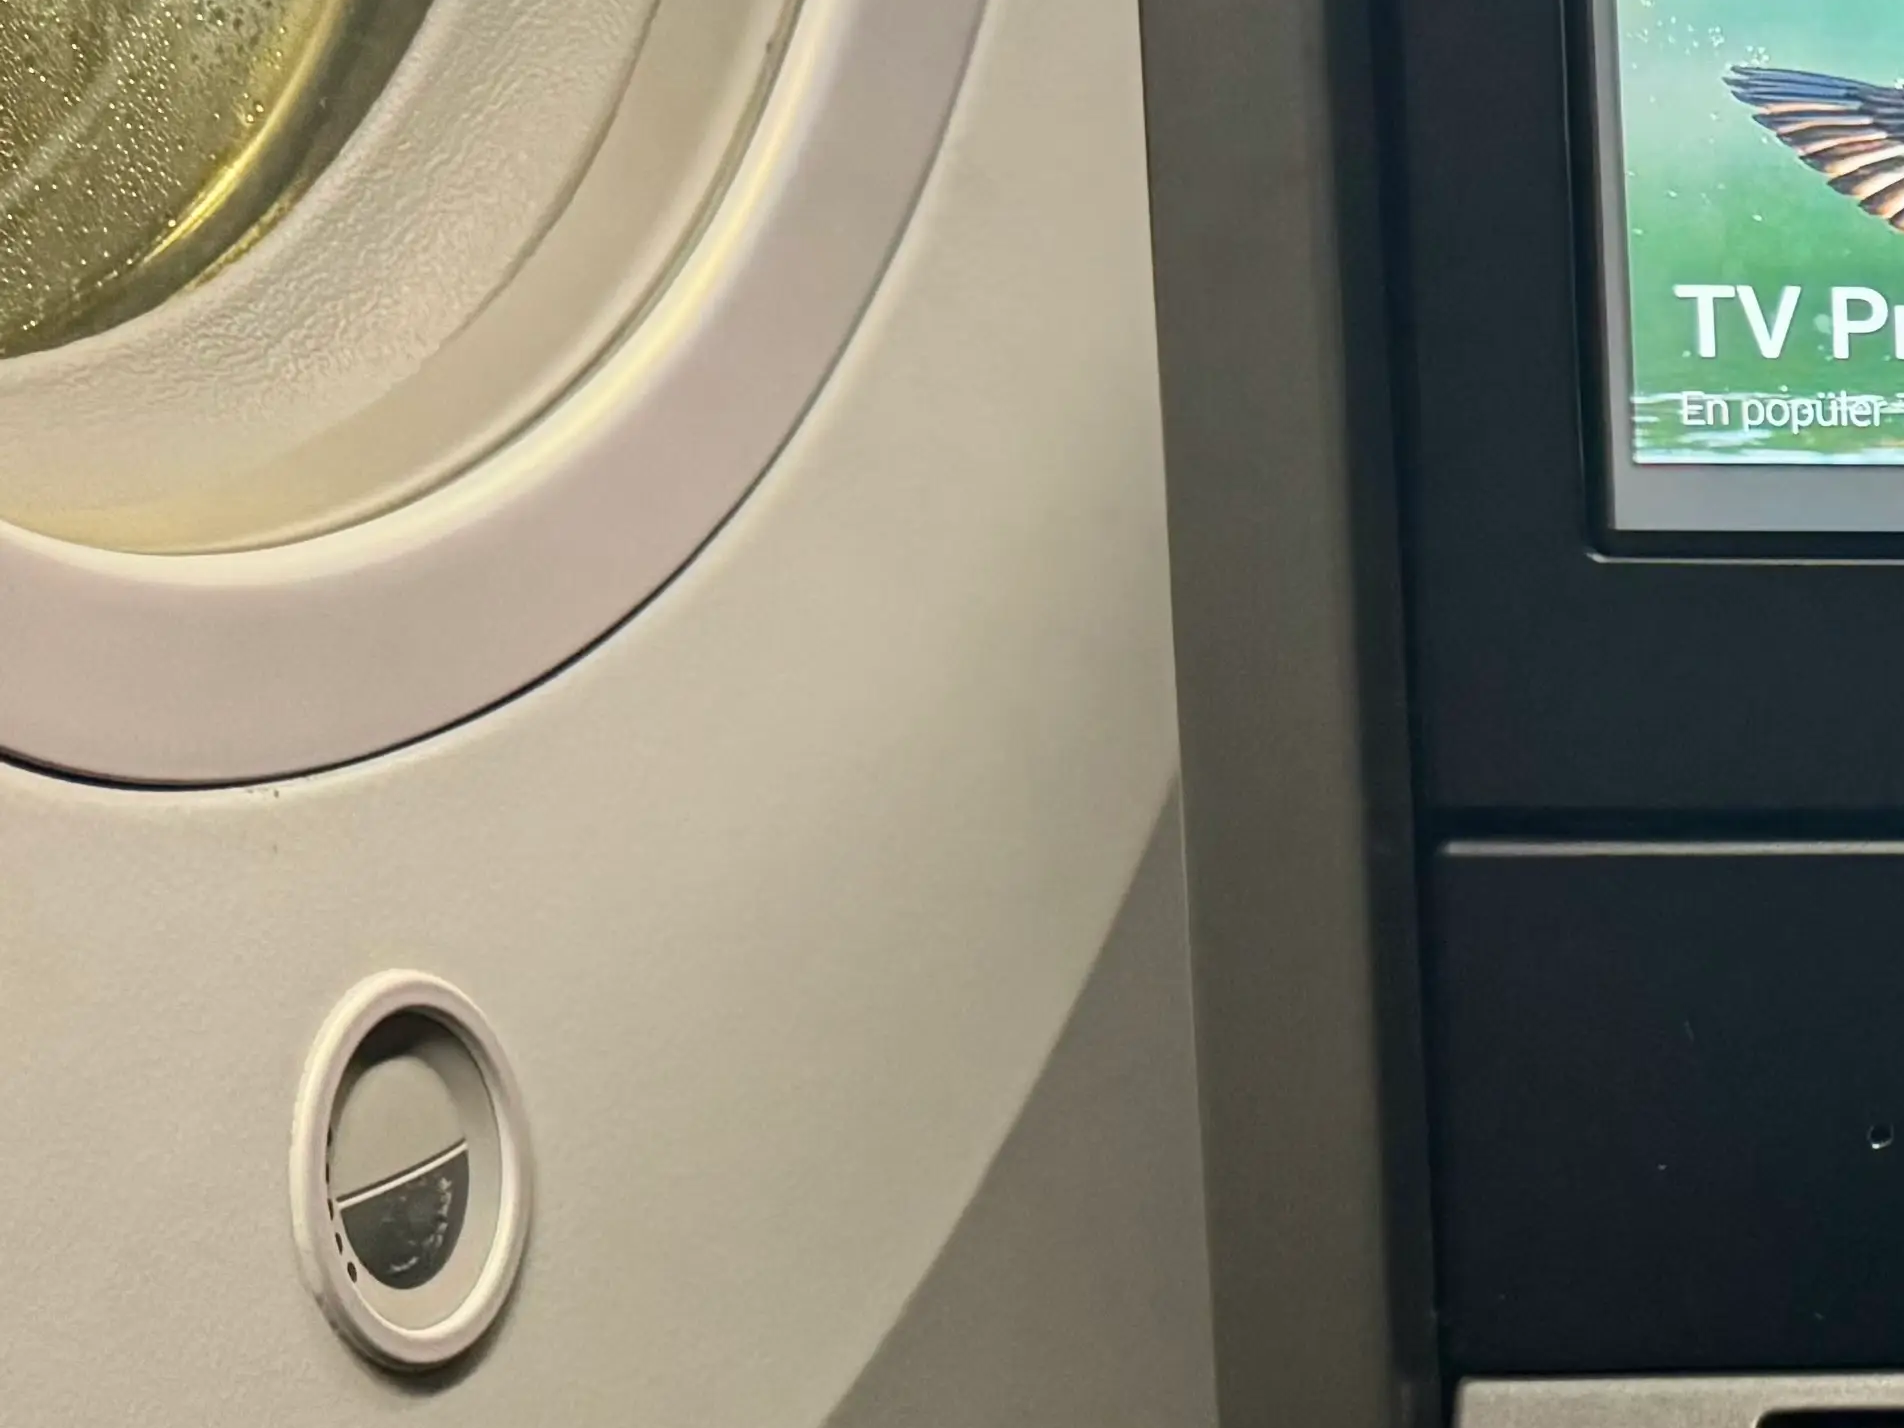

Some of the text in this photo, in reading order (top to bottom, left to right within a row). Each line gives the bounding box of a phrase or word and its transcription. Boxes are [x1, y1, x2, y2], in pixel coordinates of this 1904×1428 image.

[1674, 283, 1800, 359] TV
[1682, 390, 1729, 428] En
[1741, 390, 1887, 437] popüler
